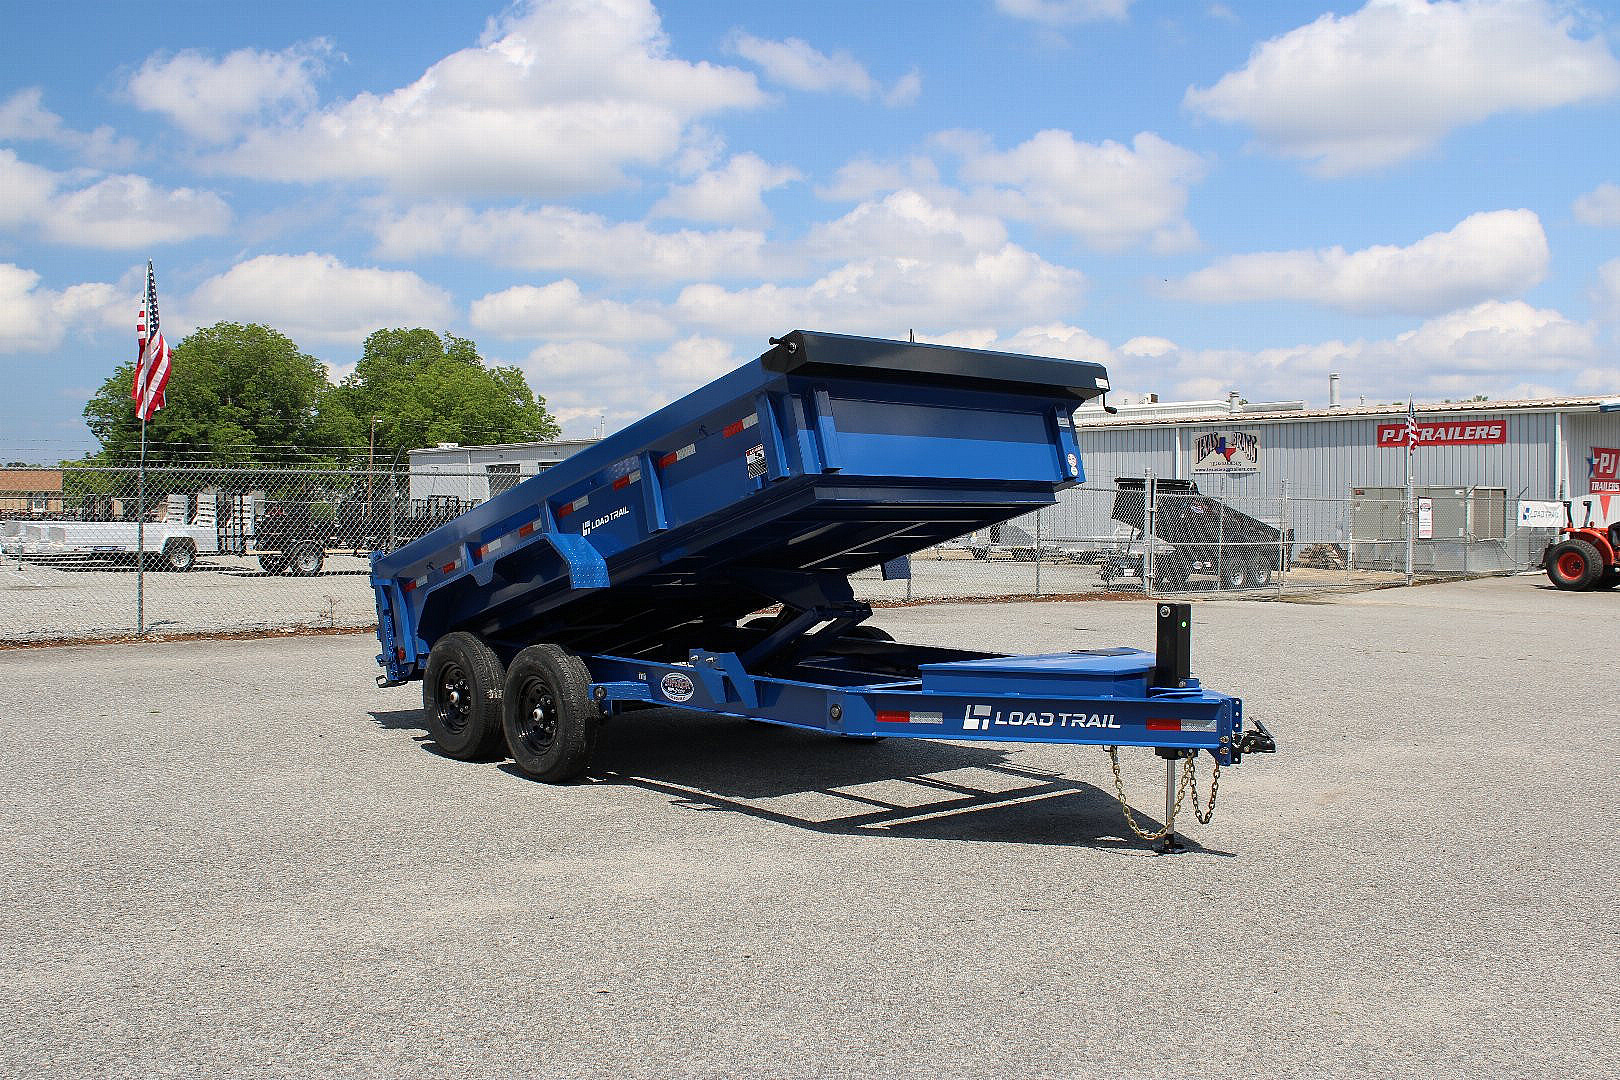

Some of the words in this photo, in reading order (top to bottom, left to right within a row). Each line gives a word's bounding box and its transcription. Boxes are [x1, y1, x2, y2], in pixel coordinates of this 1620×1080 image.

[1381, 428, 1405, 442] PJ
[1195, 431, 1219, 465] TEXAS
[1232, 431, 1258, 464] BRAGG
[1599, 452, 1616, 474] PJ
[1591, 481, 1620, 491] TRAILERS
[591, 514, 610, 530] LOAD
[610, 505, 630, 521] TRAIL
[994, 711, 1055, 727] LOAD
[1058, 712, 1121, 729] TRAIL
